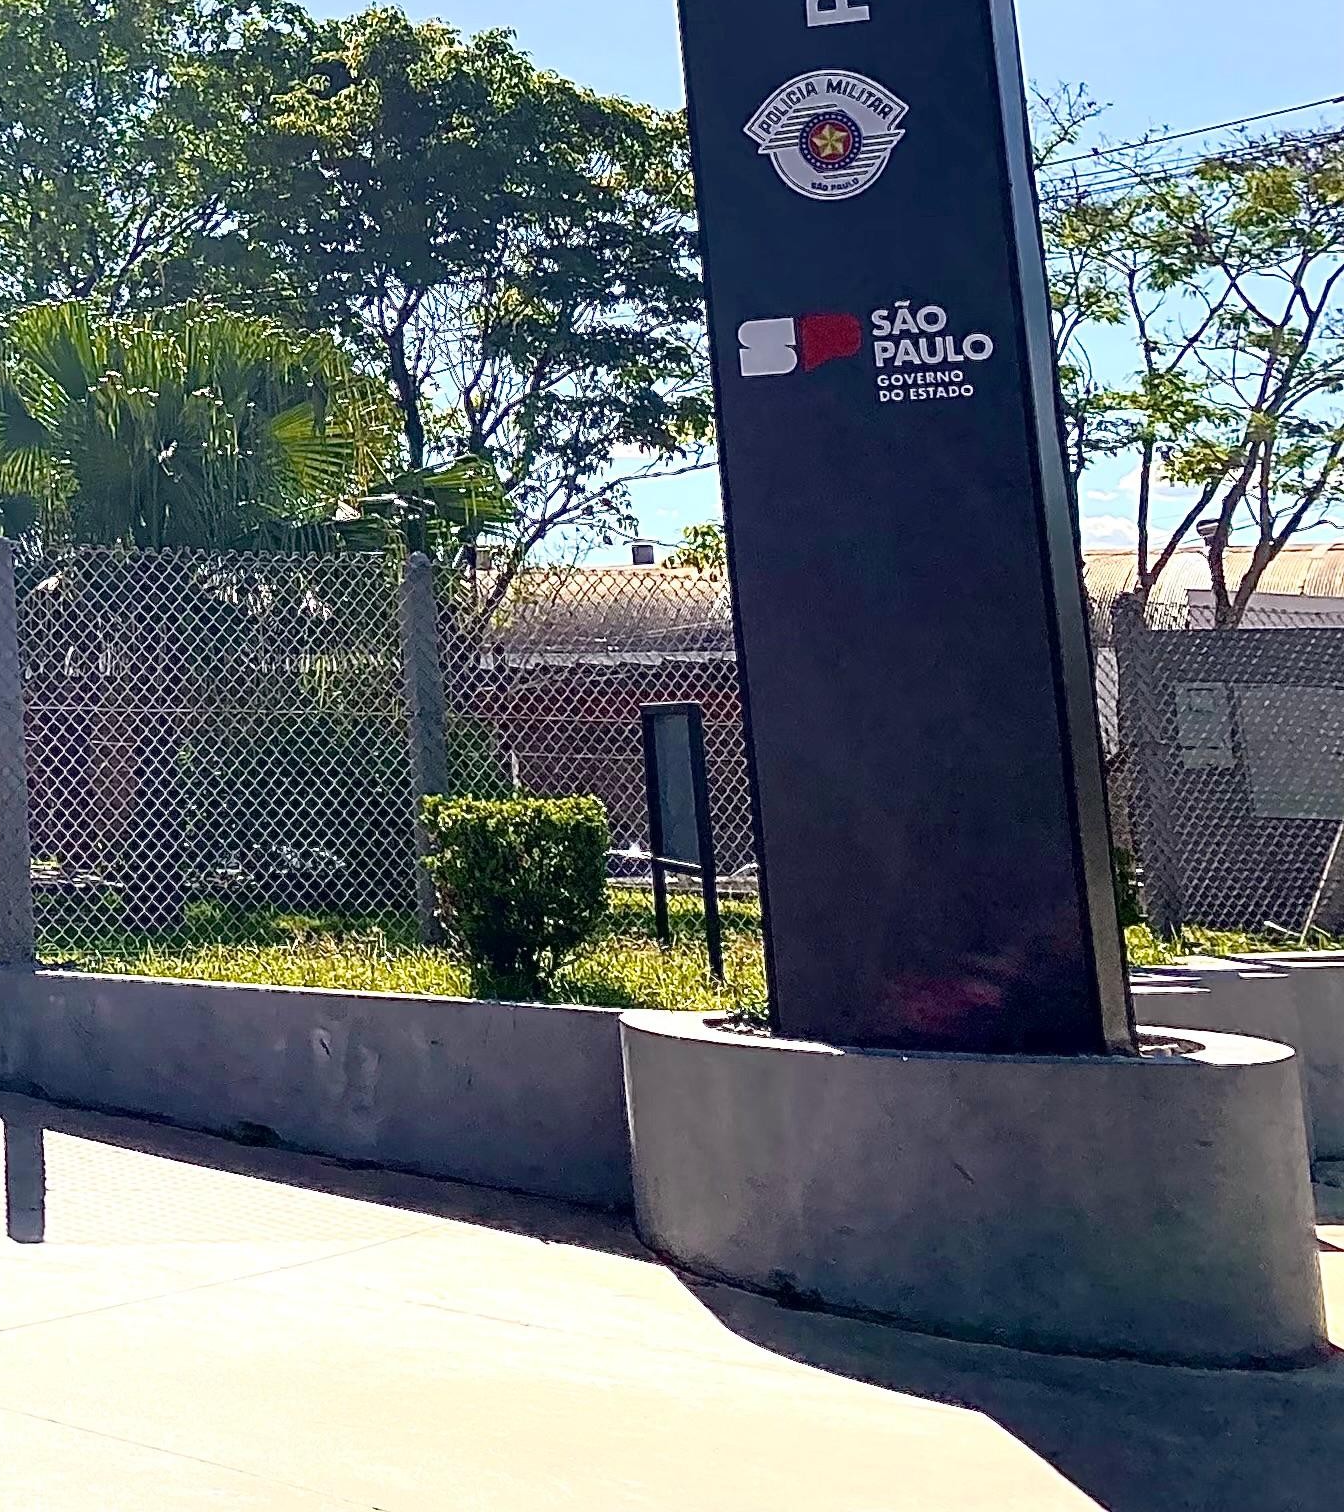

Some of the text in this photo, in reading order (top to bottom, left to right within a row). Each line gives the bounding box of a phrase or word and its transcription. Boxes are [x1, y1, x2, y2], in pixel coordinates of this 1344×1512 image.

[758, 78, 894, 135] POLICIA MILITAR
[871, 299, 947, 336] SÃO
[873, 333, 994, 367] PAULO
[876, 370, 963, 387] GOVERNO
[878, 385, 974, 402] DO ESTADO
